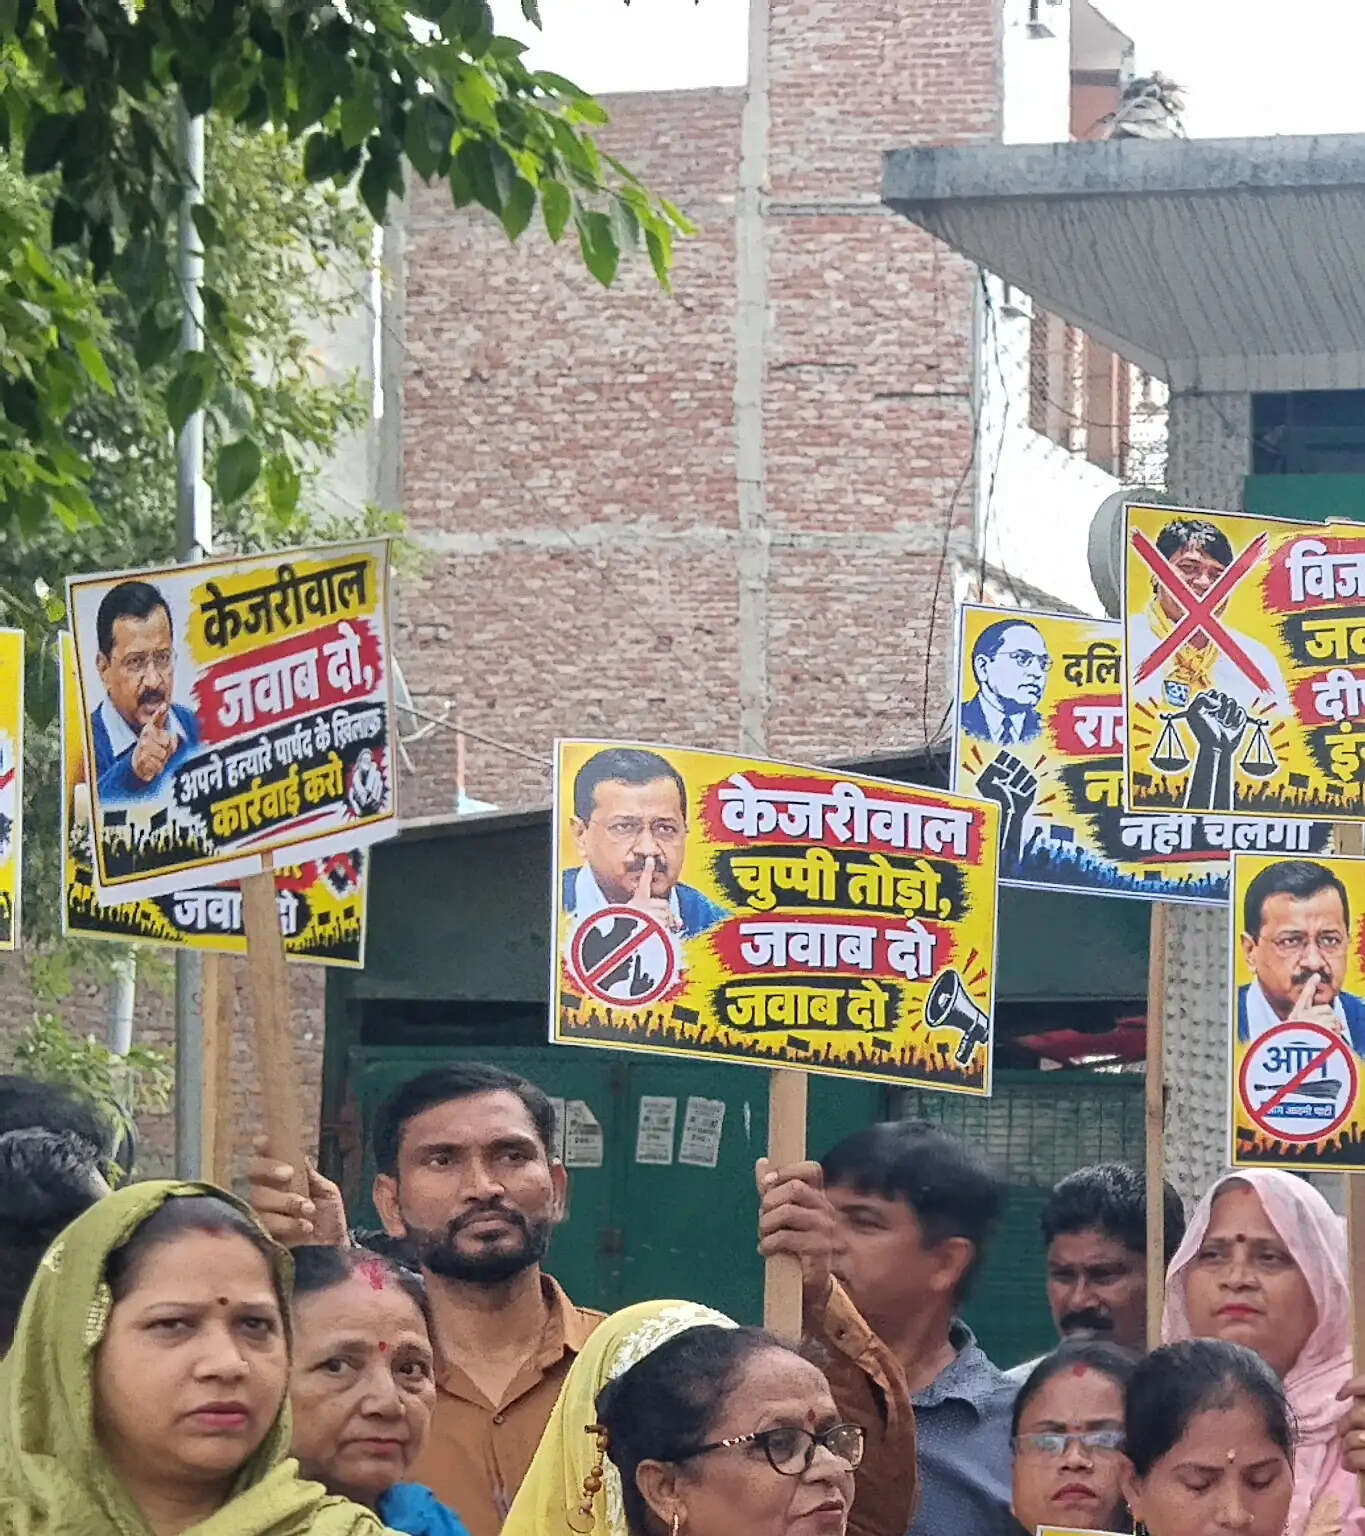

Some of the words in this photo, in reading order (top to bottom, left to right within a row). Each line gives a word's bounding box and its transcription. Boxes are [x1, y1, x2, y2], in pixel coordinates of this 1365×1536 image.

[200, 560, 369, 648] केजरीवाल
[214, 647, 319, 728] जवाब
[323, 620, 374, 694] दो,
[180, 752, 225, 802] अपने
[314, 716, 331, 752] के
[210, 762, 300, 837] कार्रवाई
[302, 751, 345, 804] करो
[718, 772, 973, 855] केजरीवाल
[173, 889, 243, 930] जवा
[730, 848, 839, 911] चुप्पी
[847, 858, 953, 921] तोड़ो,
[738, 921, 877, 971] जवाब
[885, 919, 937, 982] दो
[725, 985, 839, 1027] जवाब
[845, 979, 890, 1033] दो
